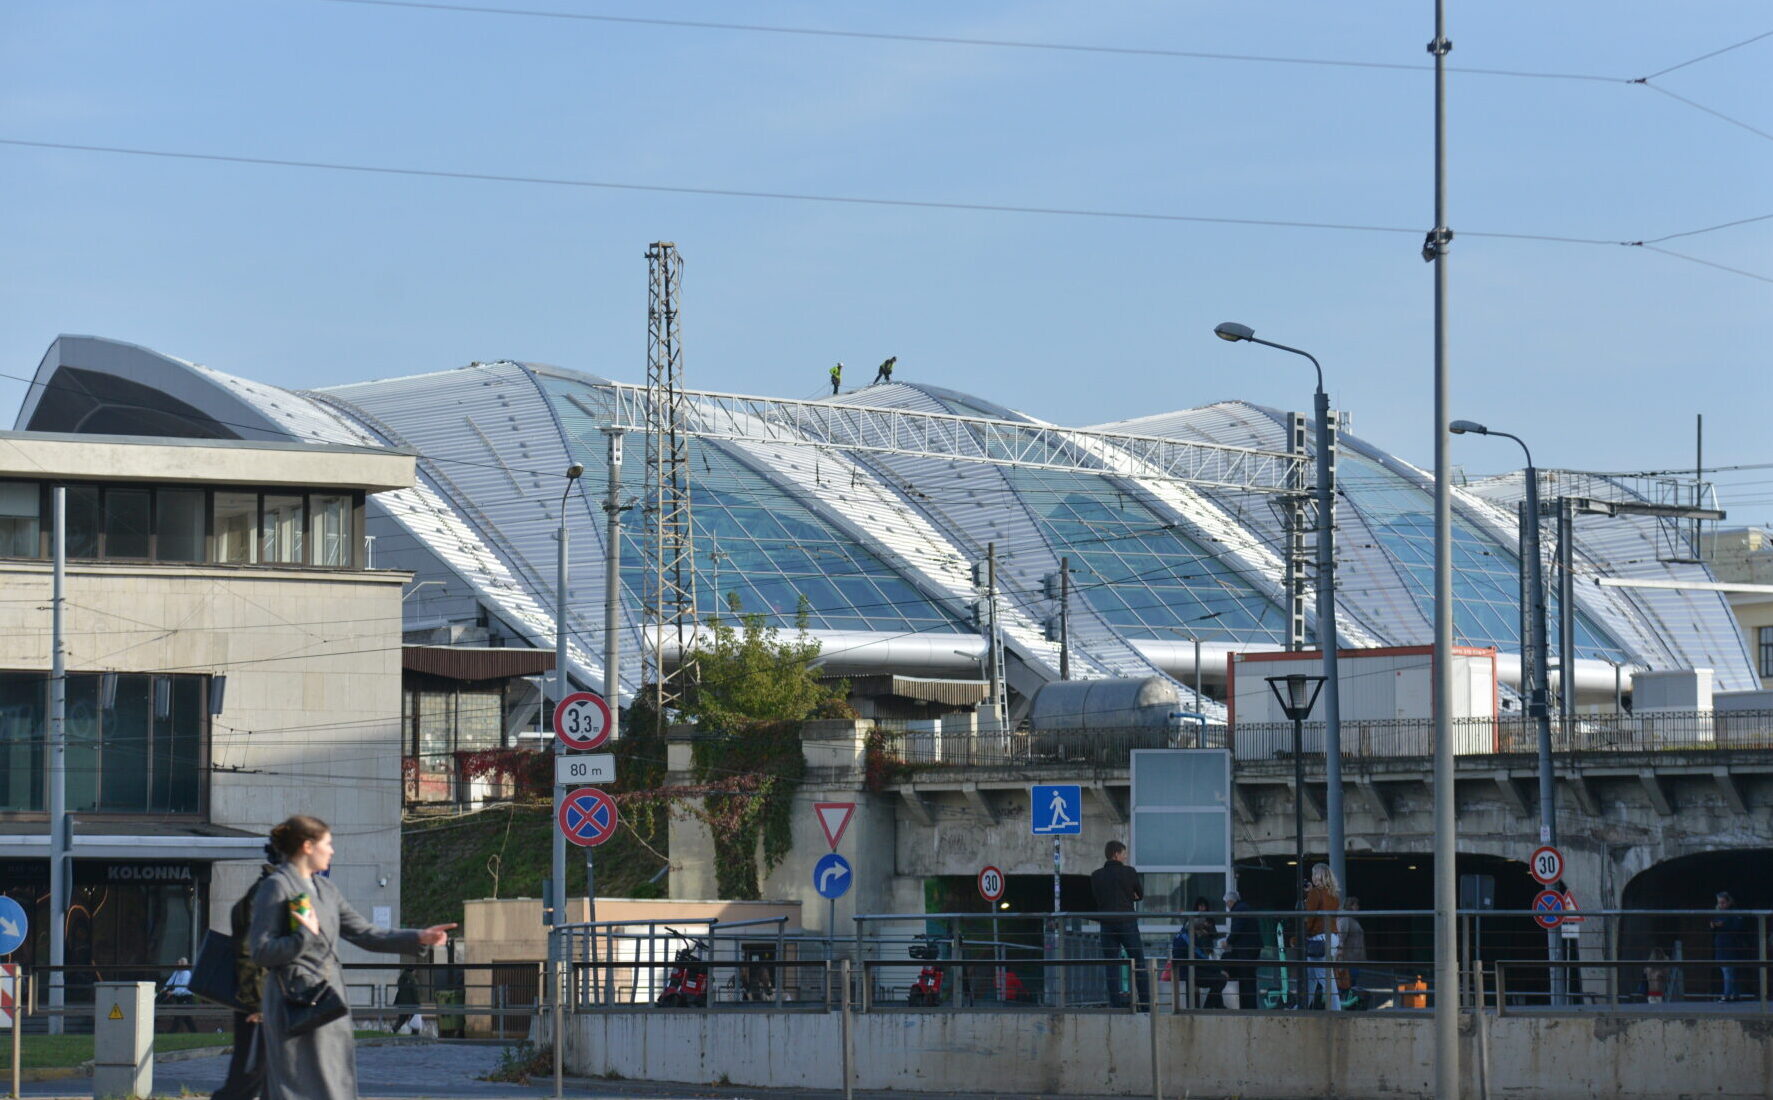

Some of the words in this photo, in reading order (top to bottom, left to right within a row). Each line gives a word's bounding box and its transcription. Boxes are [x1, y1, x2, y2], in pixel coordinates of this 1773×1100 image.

[570, 763, 587, 776] 80
[591, 767, 602, 776] m
[107, 866, 192, 880] KOLONNA
[1539, 855, 1555, 875] 30
[984, 874, 998, 892] 30
